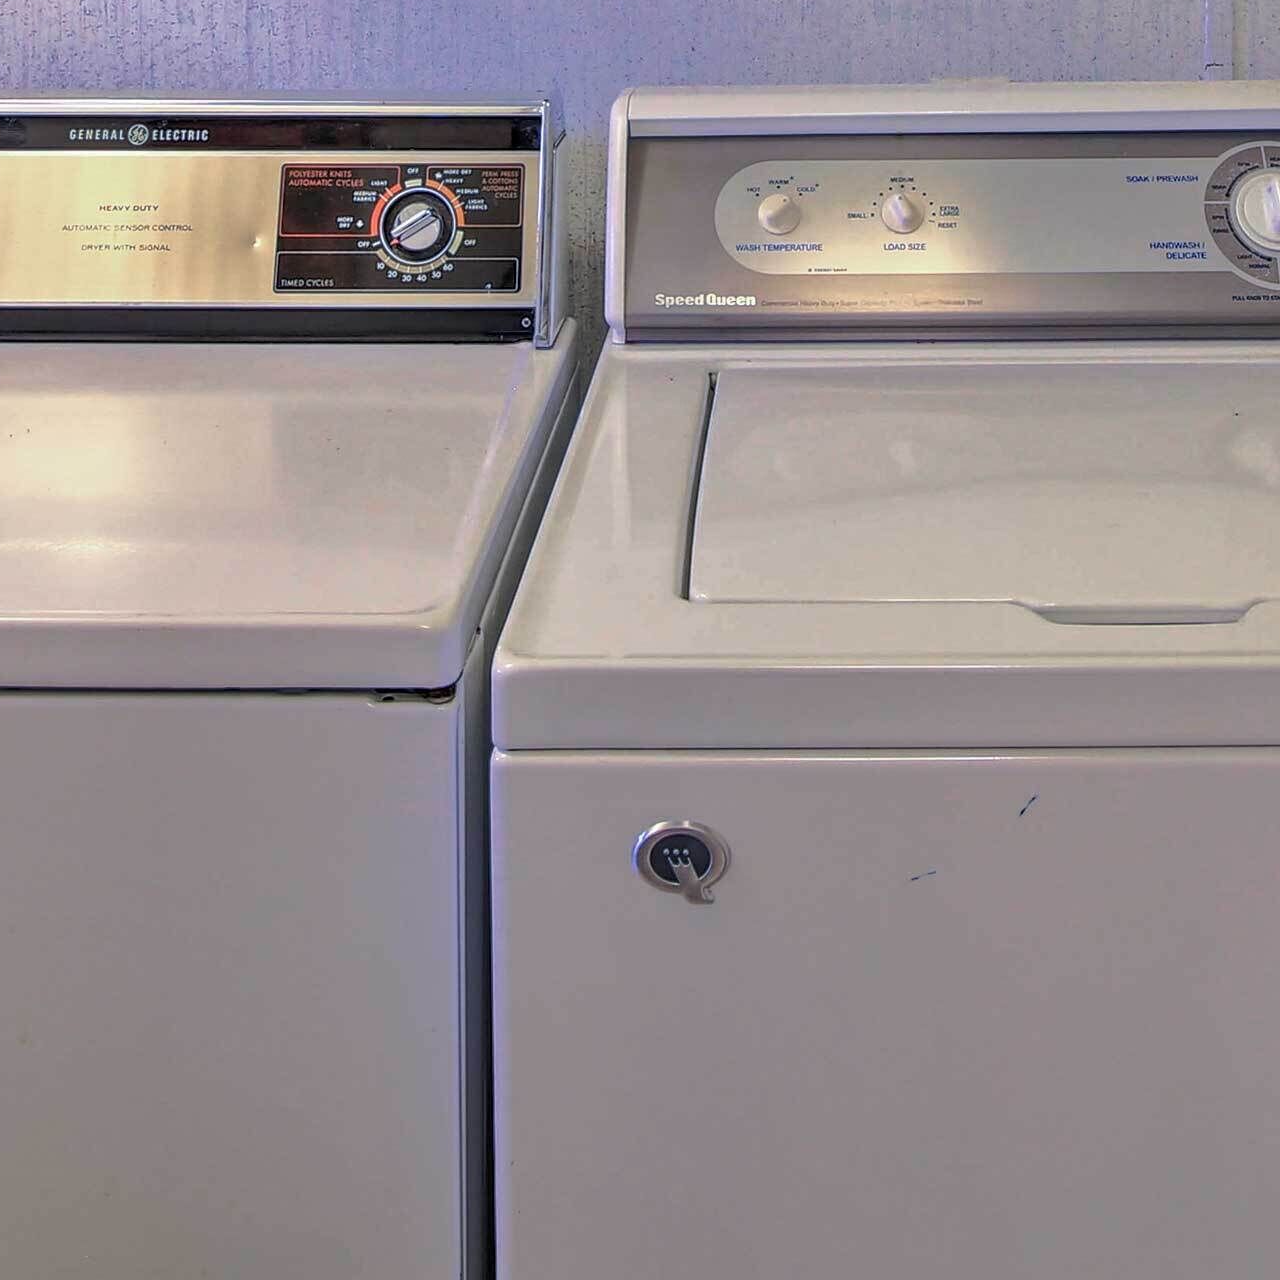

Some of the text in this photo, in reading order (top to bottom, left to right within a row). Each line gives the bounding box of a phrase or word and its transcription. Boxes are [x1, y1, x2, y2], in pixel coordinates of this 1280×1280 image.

[69, 129, 209, 141] GENERAL ELECTRIC
[288, 170, 328, 178] POLYESTER
[288, 179, 364, 187] AUTOMATIC CYCLES
[1126, 175, 1149, 183] SOAK
[735, 243, 823, 251] WASH TEMPERATURE
[883, 243, 927, 251] LOAD SIZE
[1149, 241, 1200, 249] HANDWASH
[377, 262, 385, 270] 10
[443, 263, 454, 271] 60
[387, 270, 398, 278] 20
[416, 274, 427, 282] 40
[431, 271, 442, 279] 50
[281, 279, 334, 287] TIMED CYCLES
[654, 293, 704, 308] Speed
[705, 293, 756, 306] Queen
